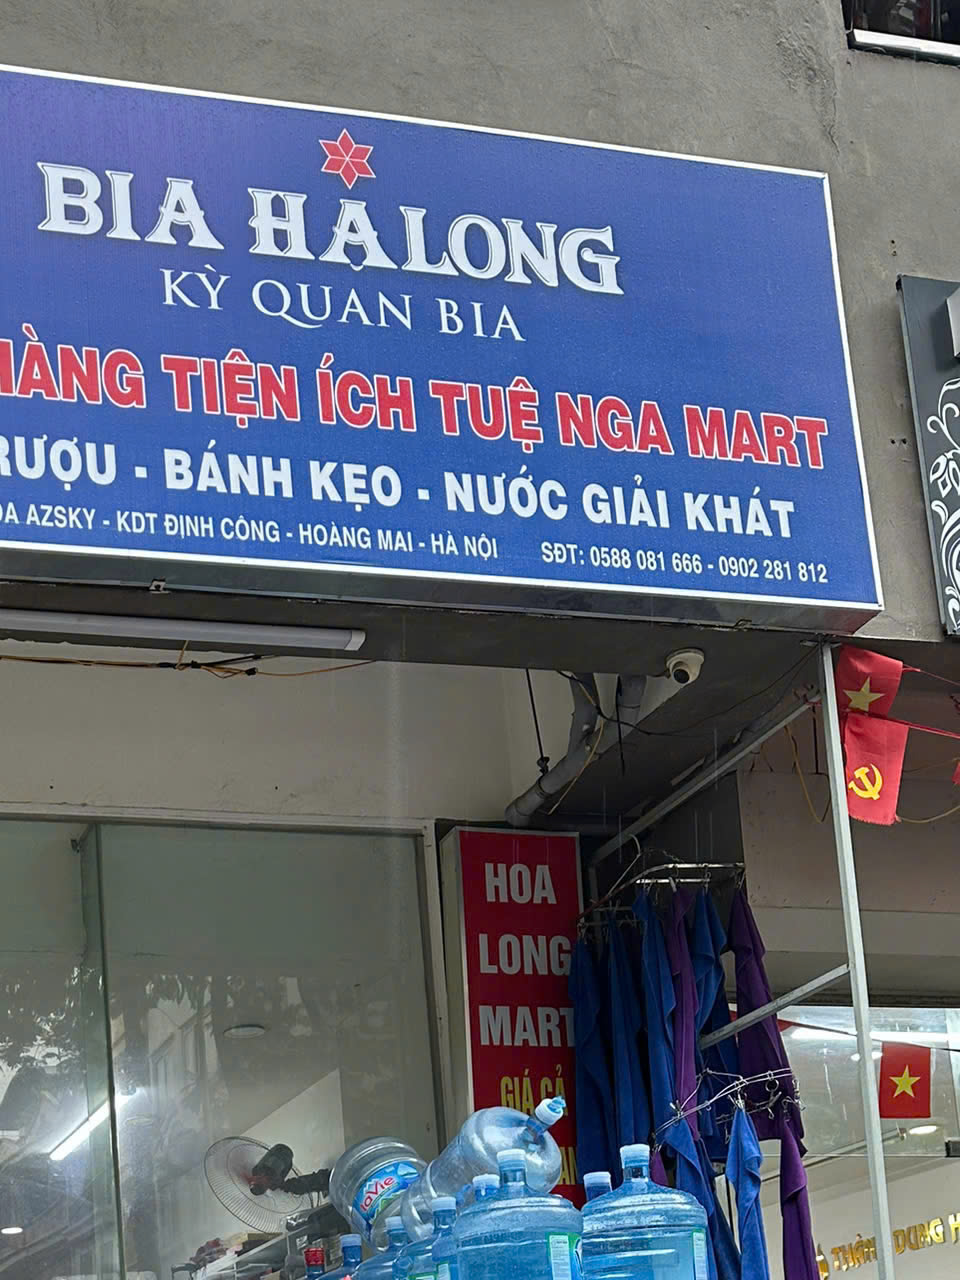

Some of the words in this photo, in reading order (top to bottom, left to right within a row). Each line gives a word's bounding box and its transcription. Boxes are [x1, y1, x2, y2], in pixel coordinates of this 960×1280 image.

[37, 161, 224, 250] BIA
[159, 264, 230, 311] KỲ
[251, 279, 413, 331] QUAN
[436, 297, 526, 342] BIA
[161, 348, 301, 428] TIỆN
[316, 354, 417, 433] ÍCH
[429, 375, 543, 453] TUỆ
[554, 391, 674, 456] NGA
[682, 404, 829, 470] MART
[163, 438, 294, 499] BÁNH
[309, 459, 403, 513] KẸO
[443, 464, 568, 521] NƯỚC
[581, 472, 671, 529] GIẢI
[683, 484, 796, 539] KHÁT
[25, 503, 97, 531] AZSKY
[116, 510, 158, 536] KDT
[163, 513, 215, 540] ĐỊNH
[220, 515, 281, 544] CÔNG
[298, 522, 372, 550] HOÀNG
[377, 530, 414, 554] MAI
[431, 532, 459, 558] HÀ
[464, 533, 498, 562] NỘI
[541, 541, 585, 567] SĐT:
[589, 547, 633, 570] 0588
[636, 550, 667, 573] 081
[671, 554, 704, 576] 666
[718, 557, 761, 580] 0902
[764, 561, 794, 583] 281
[798, 564, 830, 585] 812
[484, 862, 557, 904] HOA
[479, 935, 571, 975] LONG
[479, 1005, 577, 1047] MART
[500, 1068, 535, 1116] GIÁ
